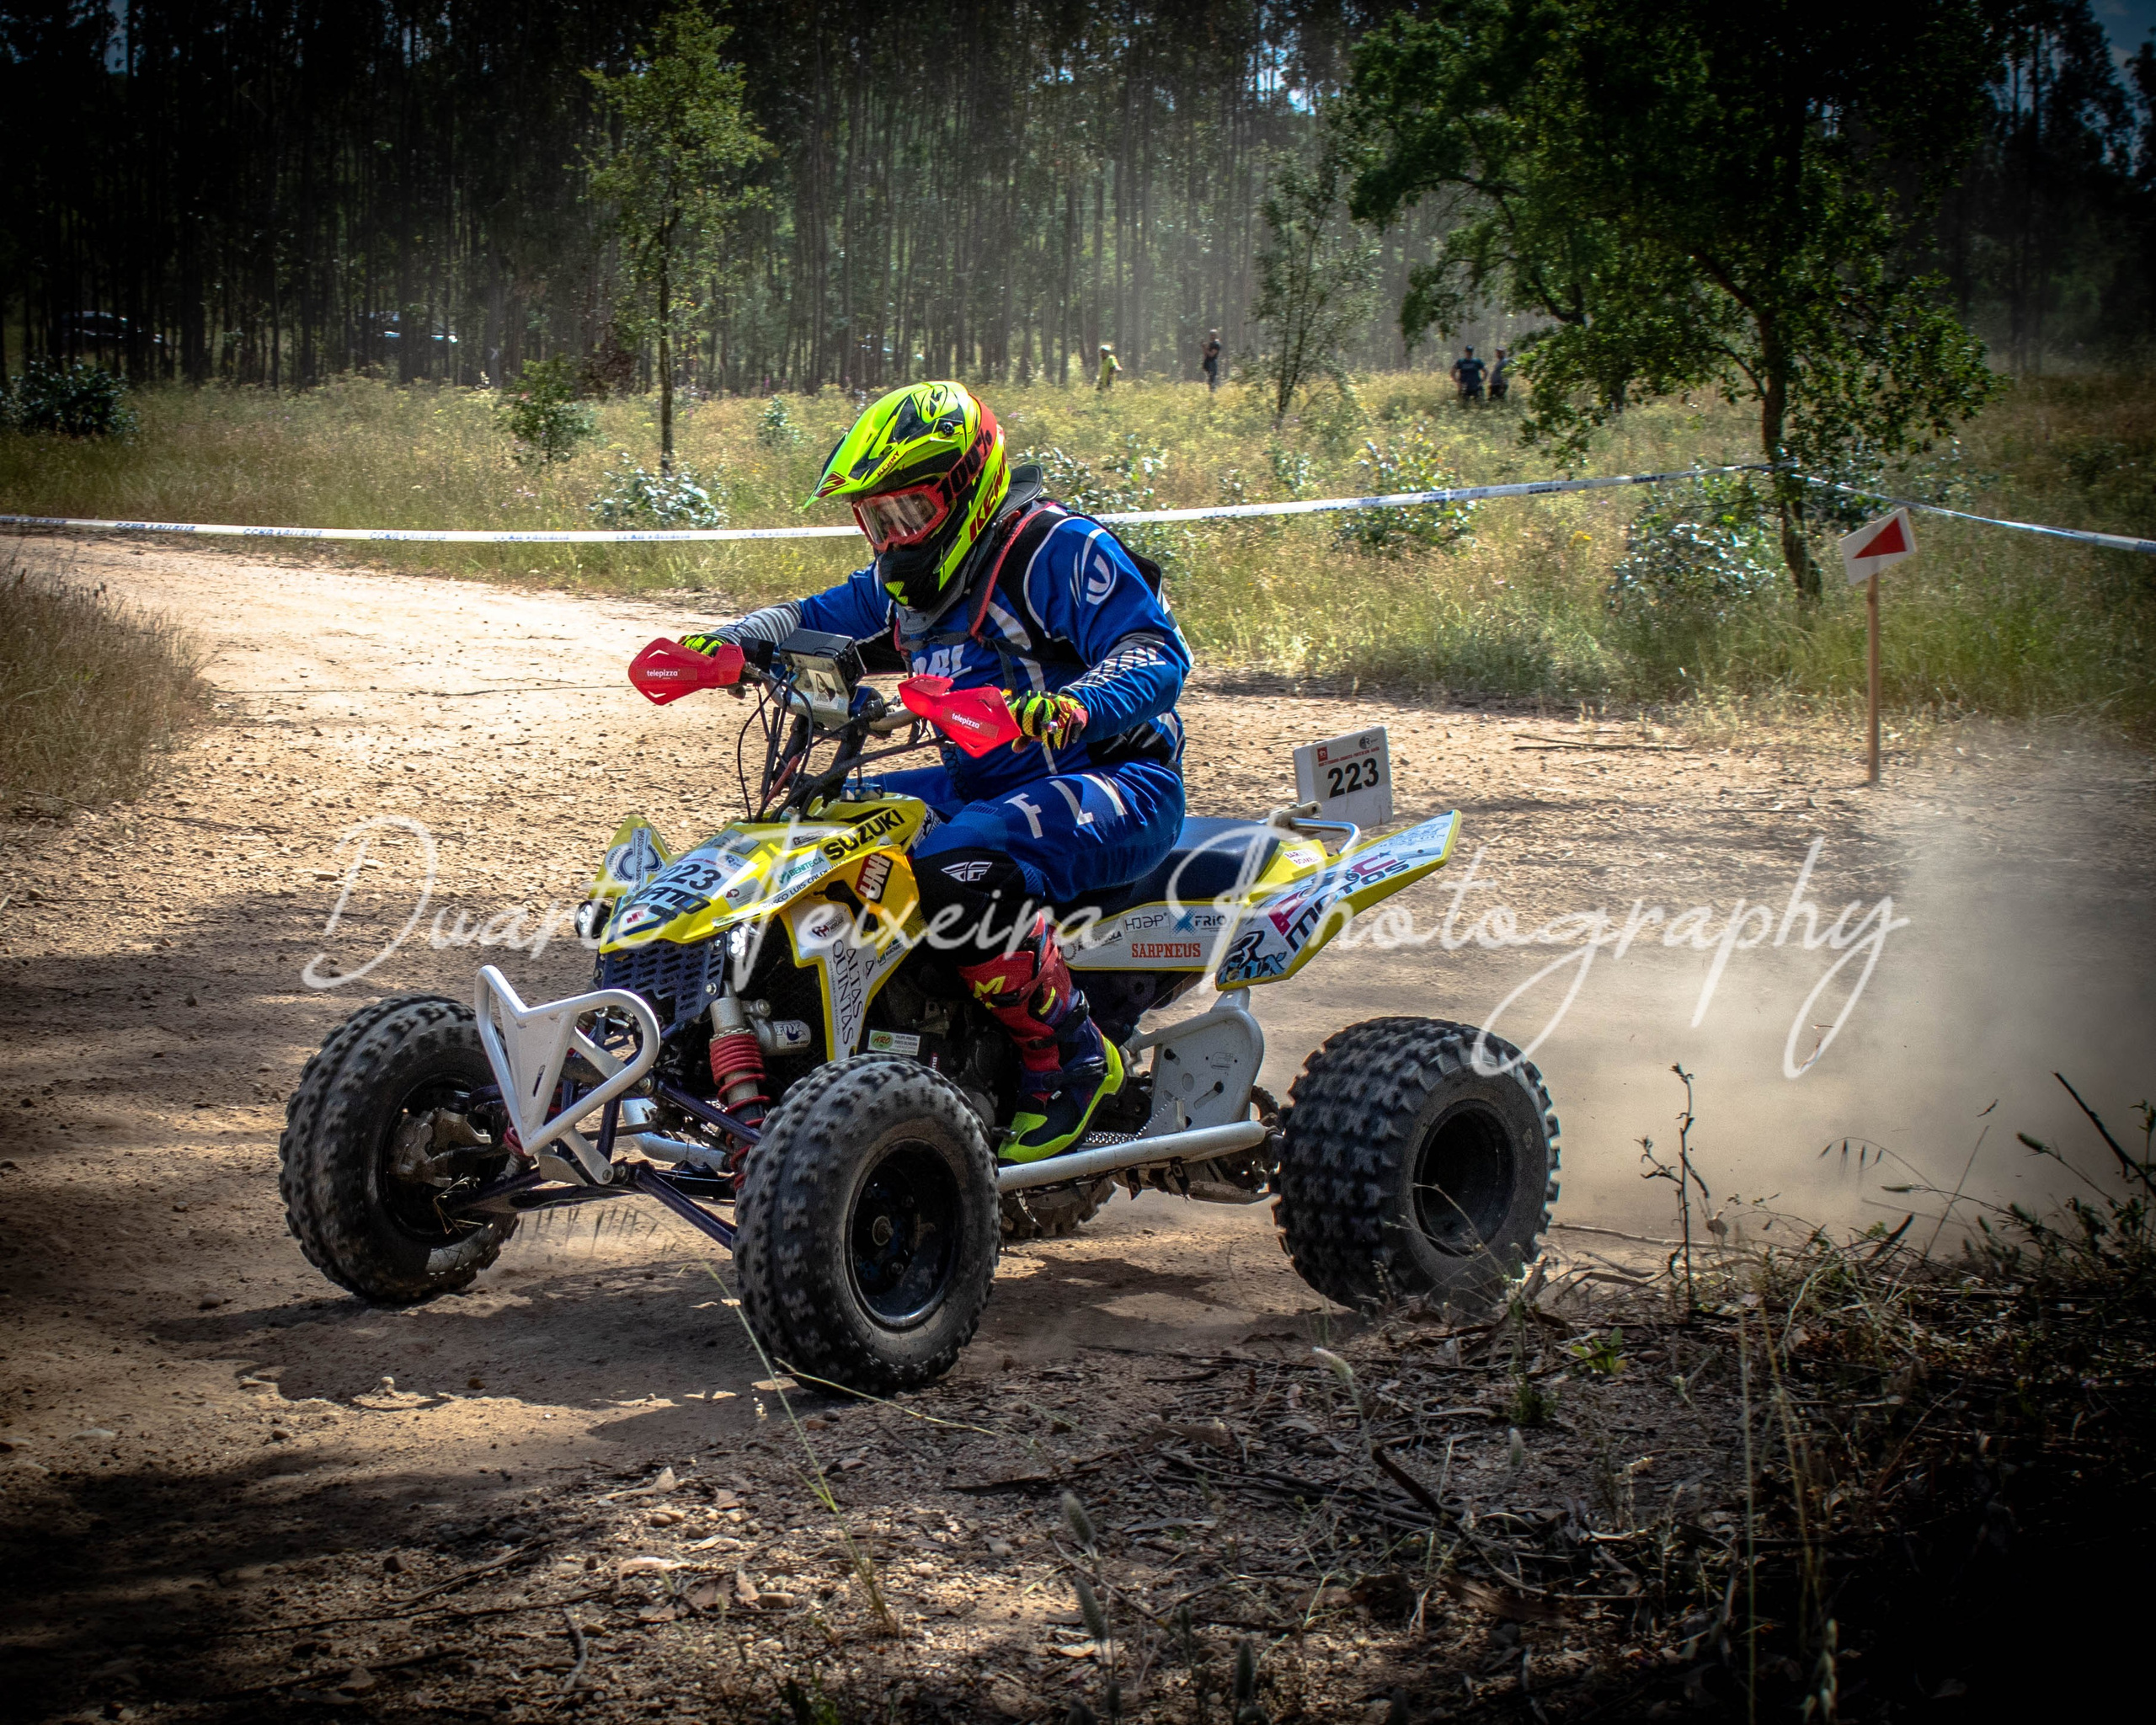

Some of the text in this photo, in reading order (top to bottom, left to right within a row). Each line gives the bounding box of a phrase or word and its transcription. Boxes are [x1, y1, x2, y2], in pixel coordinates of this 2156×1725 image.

[937, 429, 992, 505] 100%
[647, 669, 678, 678] telepizza
[952, 713, 980, 729] telepizza
[1327, 757, 1380, 798] 223
[823, 809, 905, 861] SUZUKI
[647, 863, 722, 890] 223
[788, 857, 825, 877] BENITECA
[789, 882, 807, 896] LUIS
[1132, 943, 1201, 959] SARPNEUS
[832, 939, 854, 1044] QUINTAS
[846, 948, 863, 1018] ALTAS
